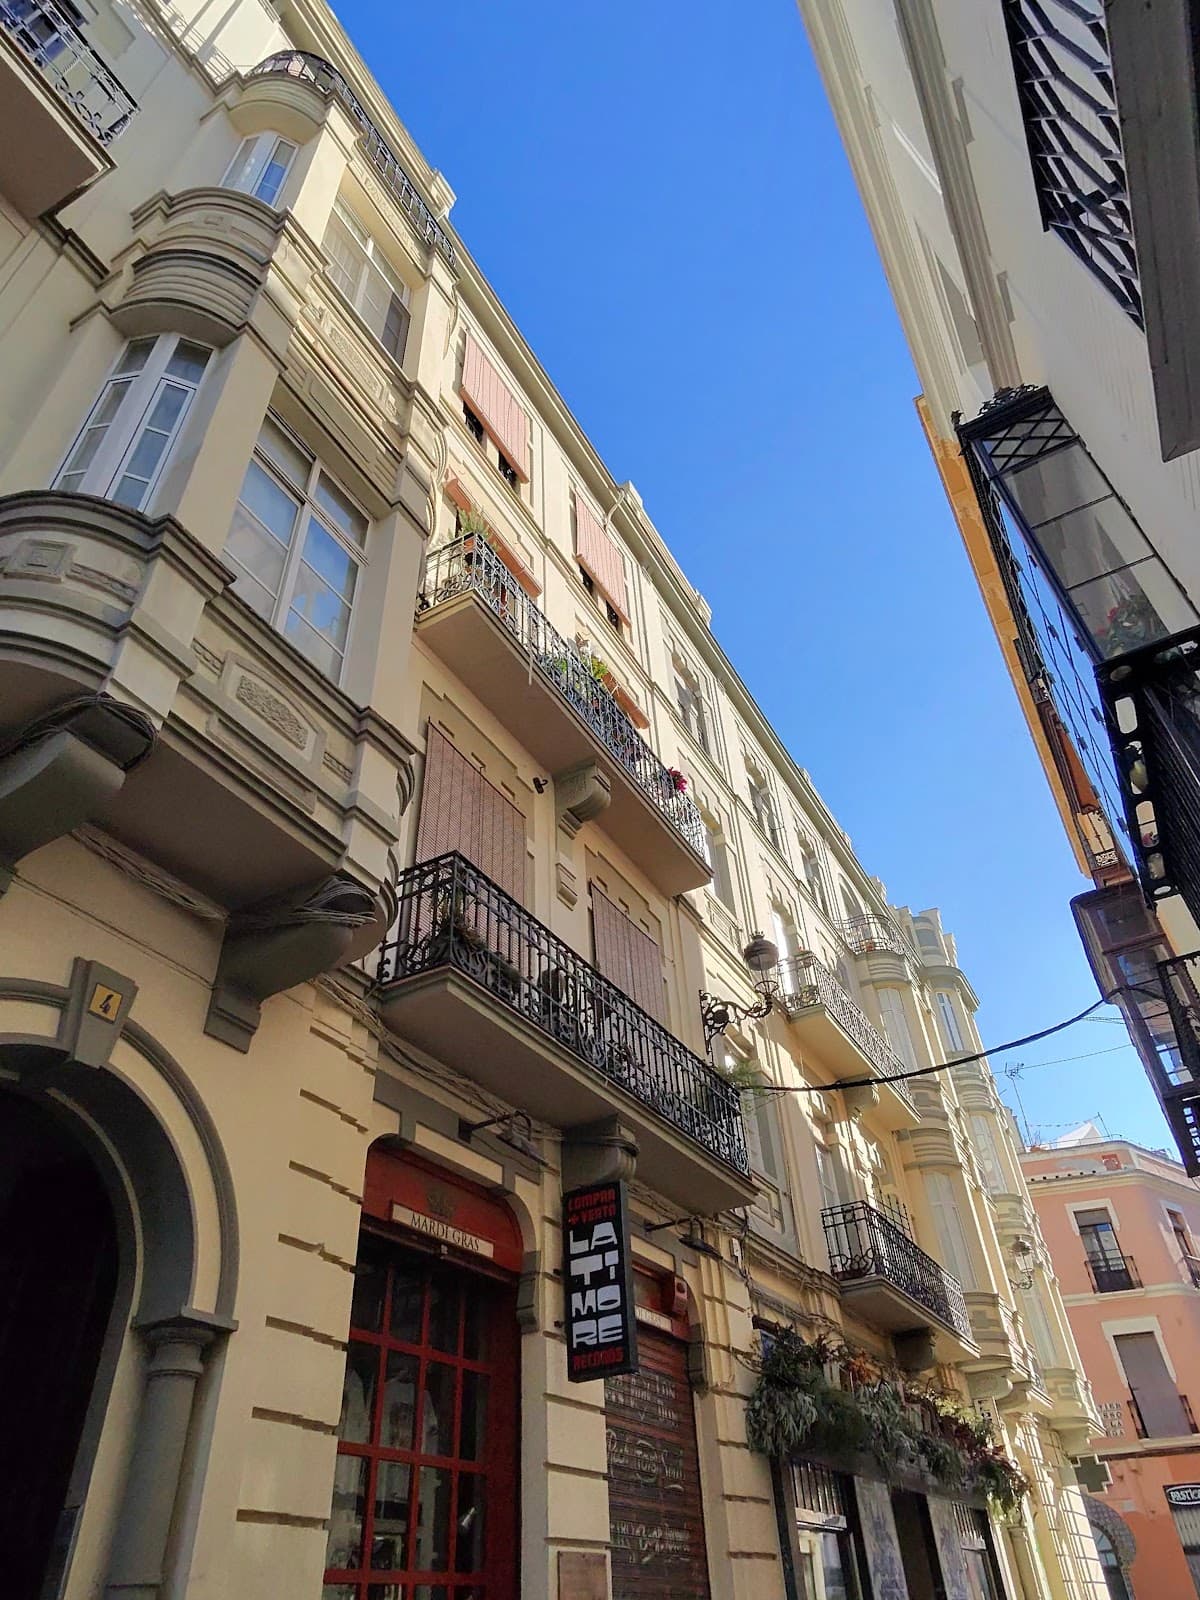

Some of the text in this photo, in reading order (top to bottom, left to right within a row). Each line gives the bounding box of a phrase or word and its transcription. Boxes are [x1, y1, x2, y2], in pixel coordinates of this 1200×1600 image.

[99, 994, 114, 1014] 4
[411, 1212, 480, 1252] MARDI GRAS
[569, 1221, 618, 1255] LA
[571, 1284, 621, 1318] MO
[572, 1313, 623, 1349] RE
